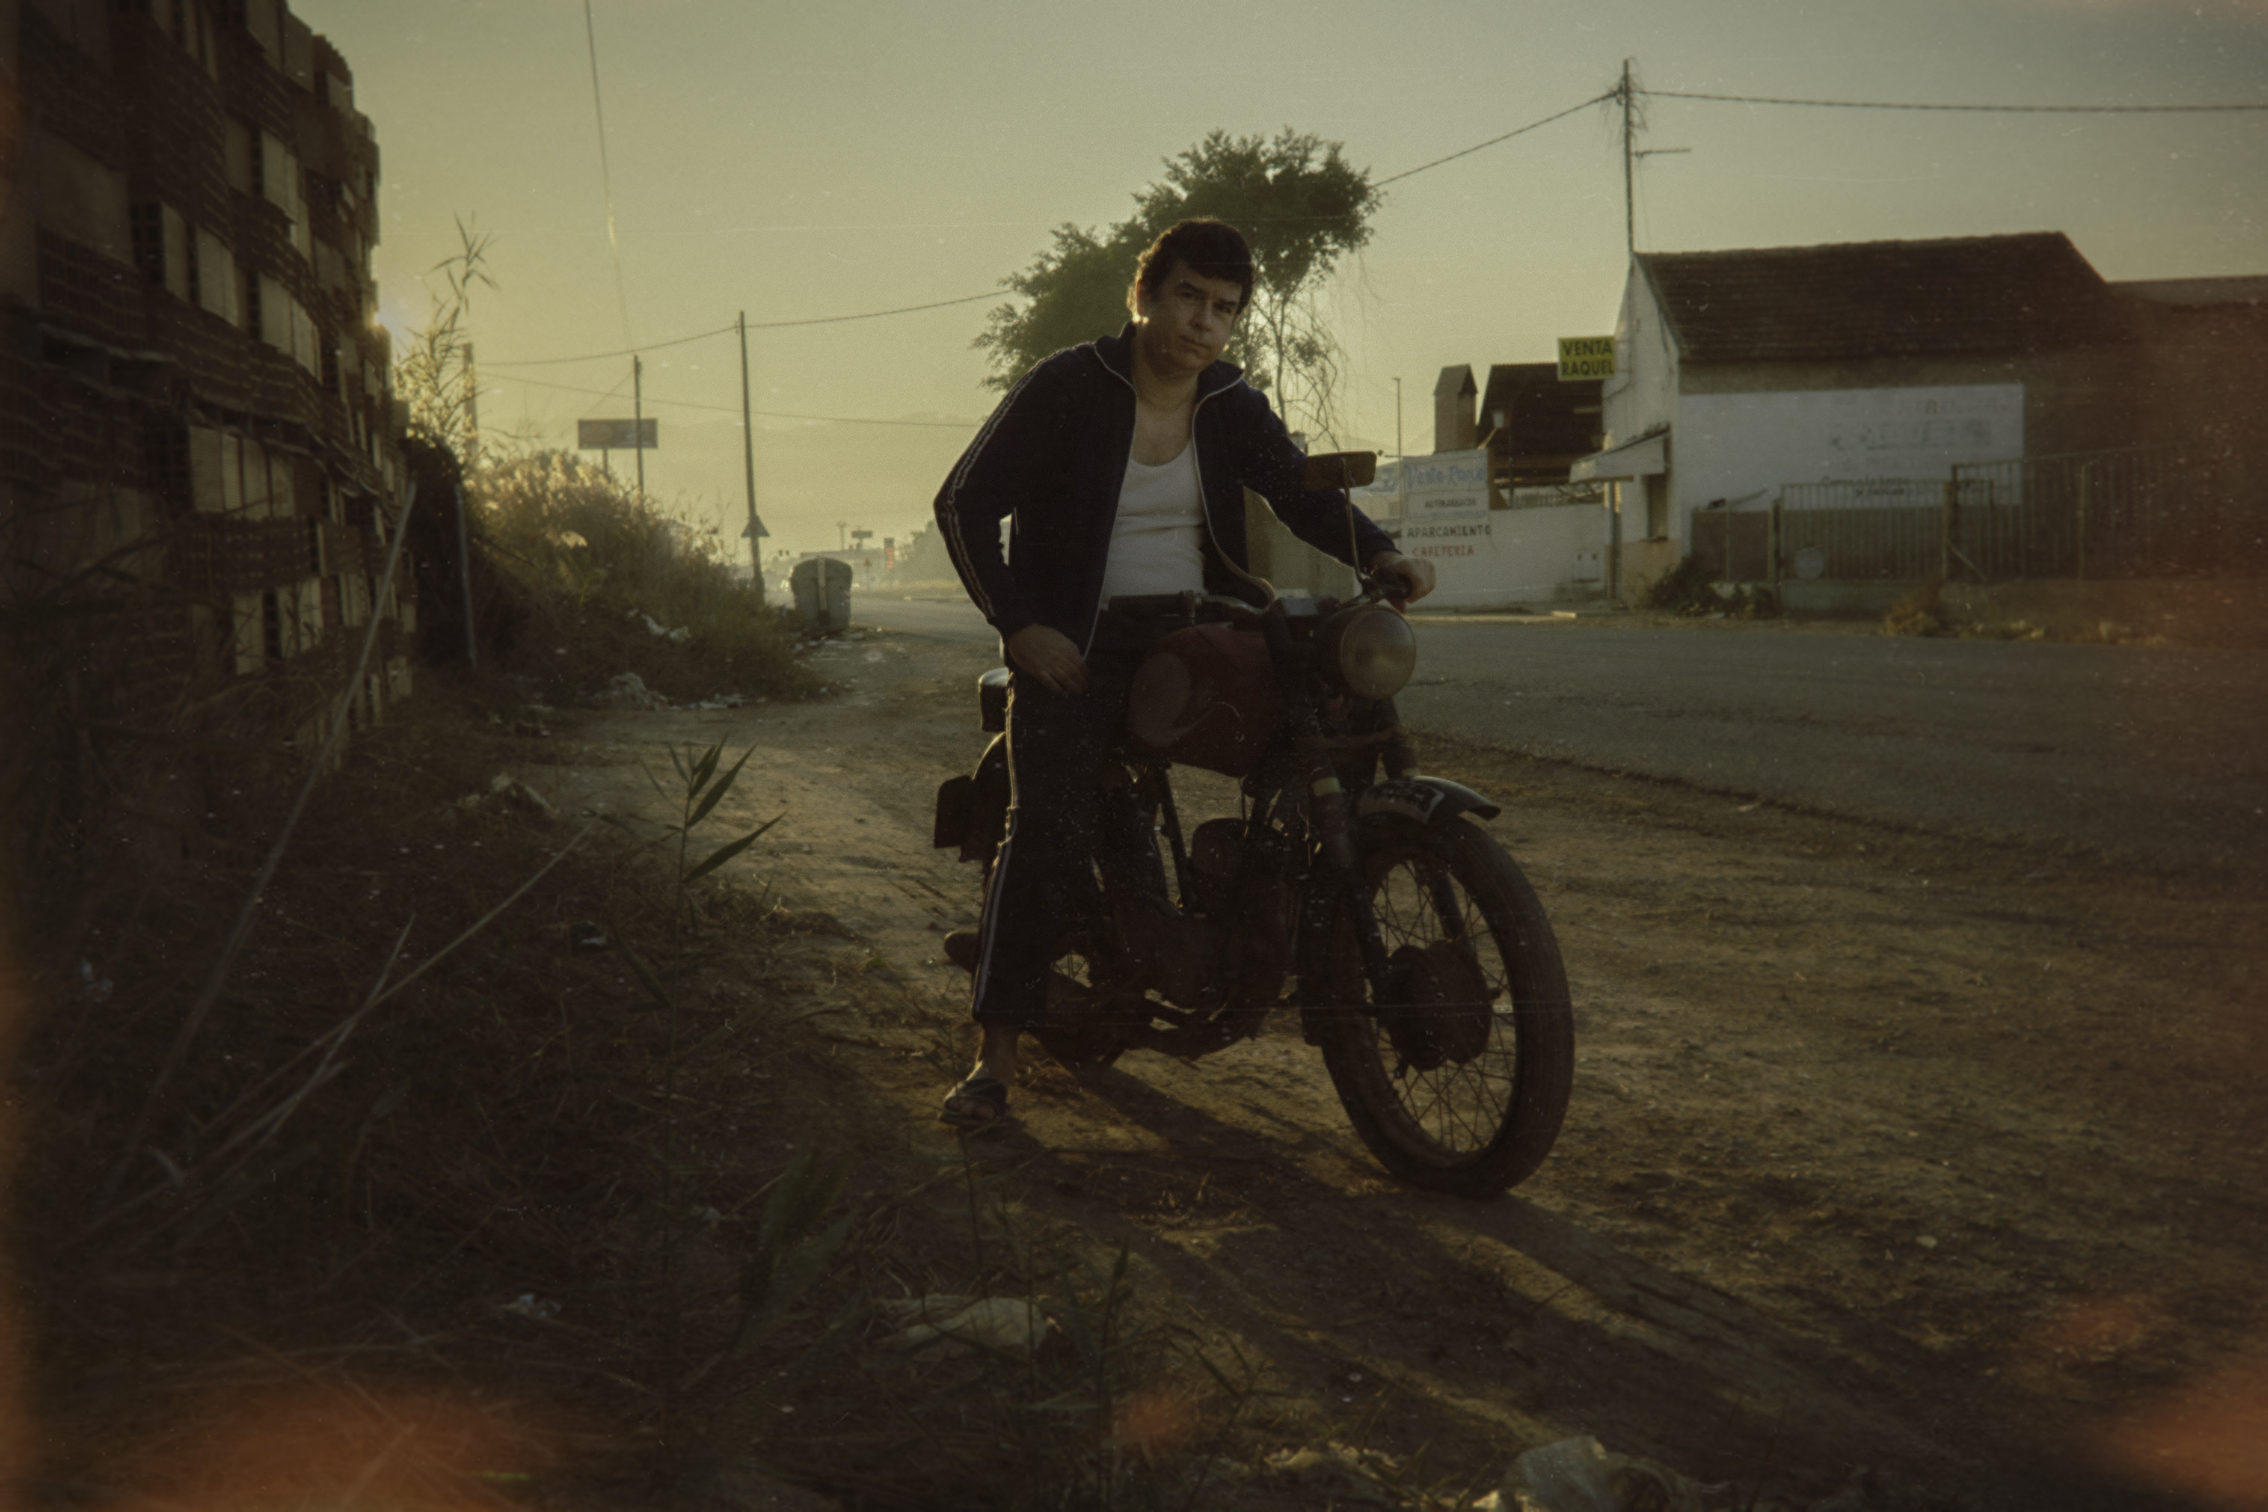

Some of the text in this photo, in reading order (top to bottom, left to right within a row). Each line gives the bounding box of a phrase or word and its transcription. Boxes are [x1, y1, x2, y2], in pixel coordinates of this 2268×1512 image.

[1562, 340, 1612, 356] VENTA
[1562, 359, 1614, 376] RAQUEL
[1407, 524, 1491, 538] APARCAMIENTO
[1412, 544, 1475, 557] CAFETERIA
